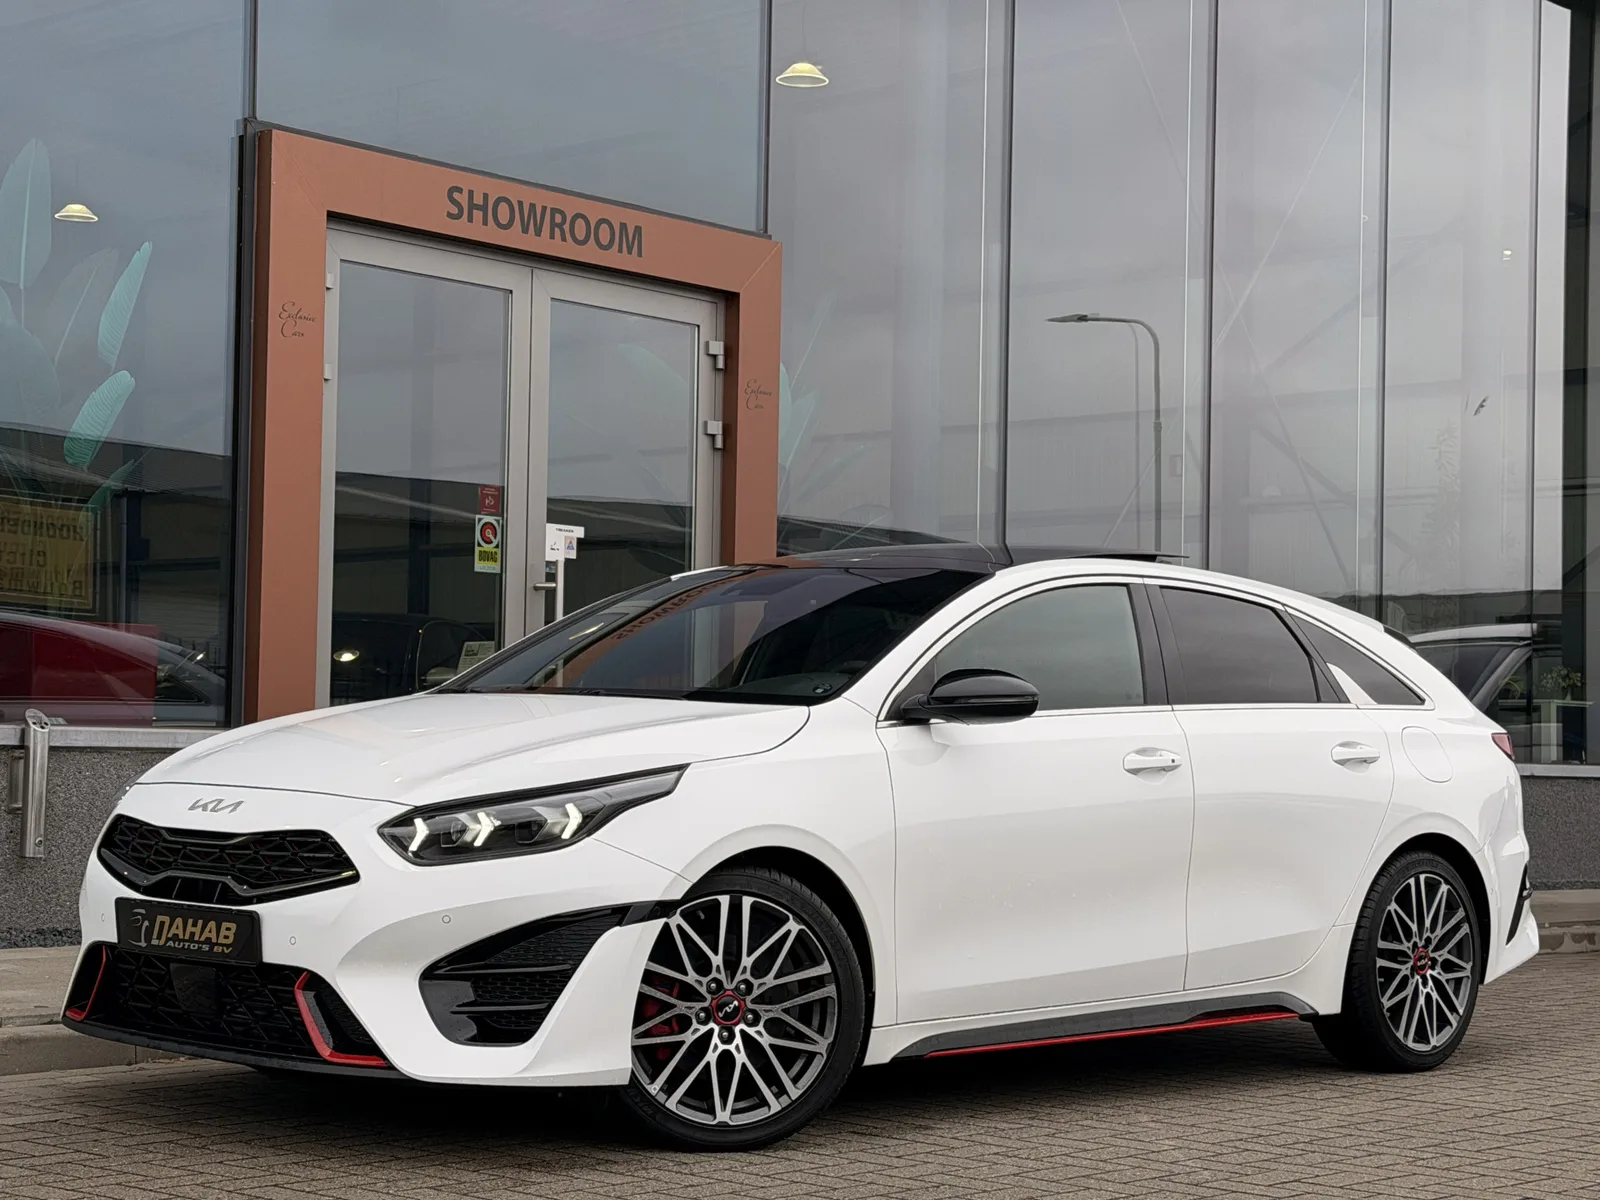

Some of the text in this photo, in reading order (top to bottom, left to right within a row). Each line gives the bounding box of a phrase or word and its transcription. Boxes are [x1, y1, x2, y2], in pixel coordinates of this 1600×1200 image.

[446, 185, 645, 258] SHOWROOM
[280, 319, 305, 338] Cars
[478, 549, 498, 563] BOVAG
[187, 797, 245, 815] KIA
[165, 940, 233, 954] AUTO'S BV
